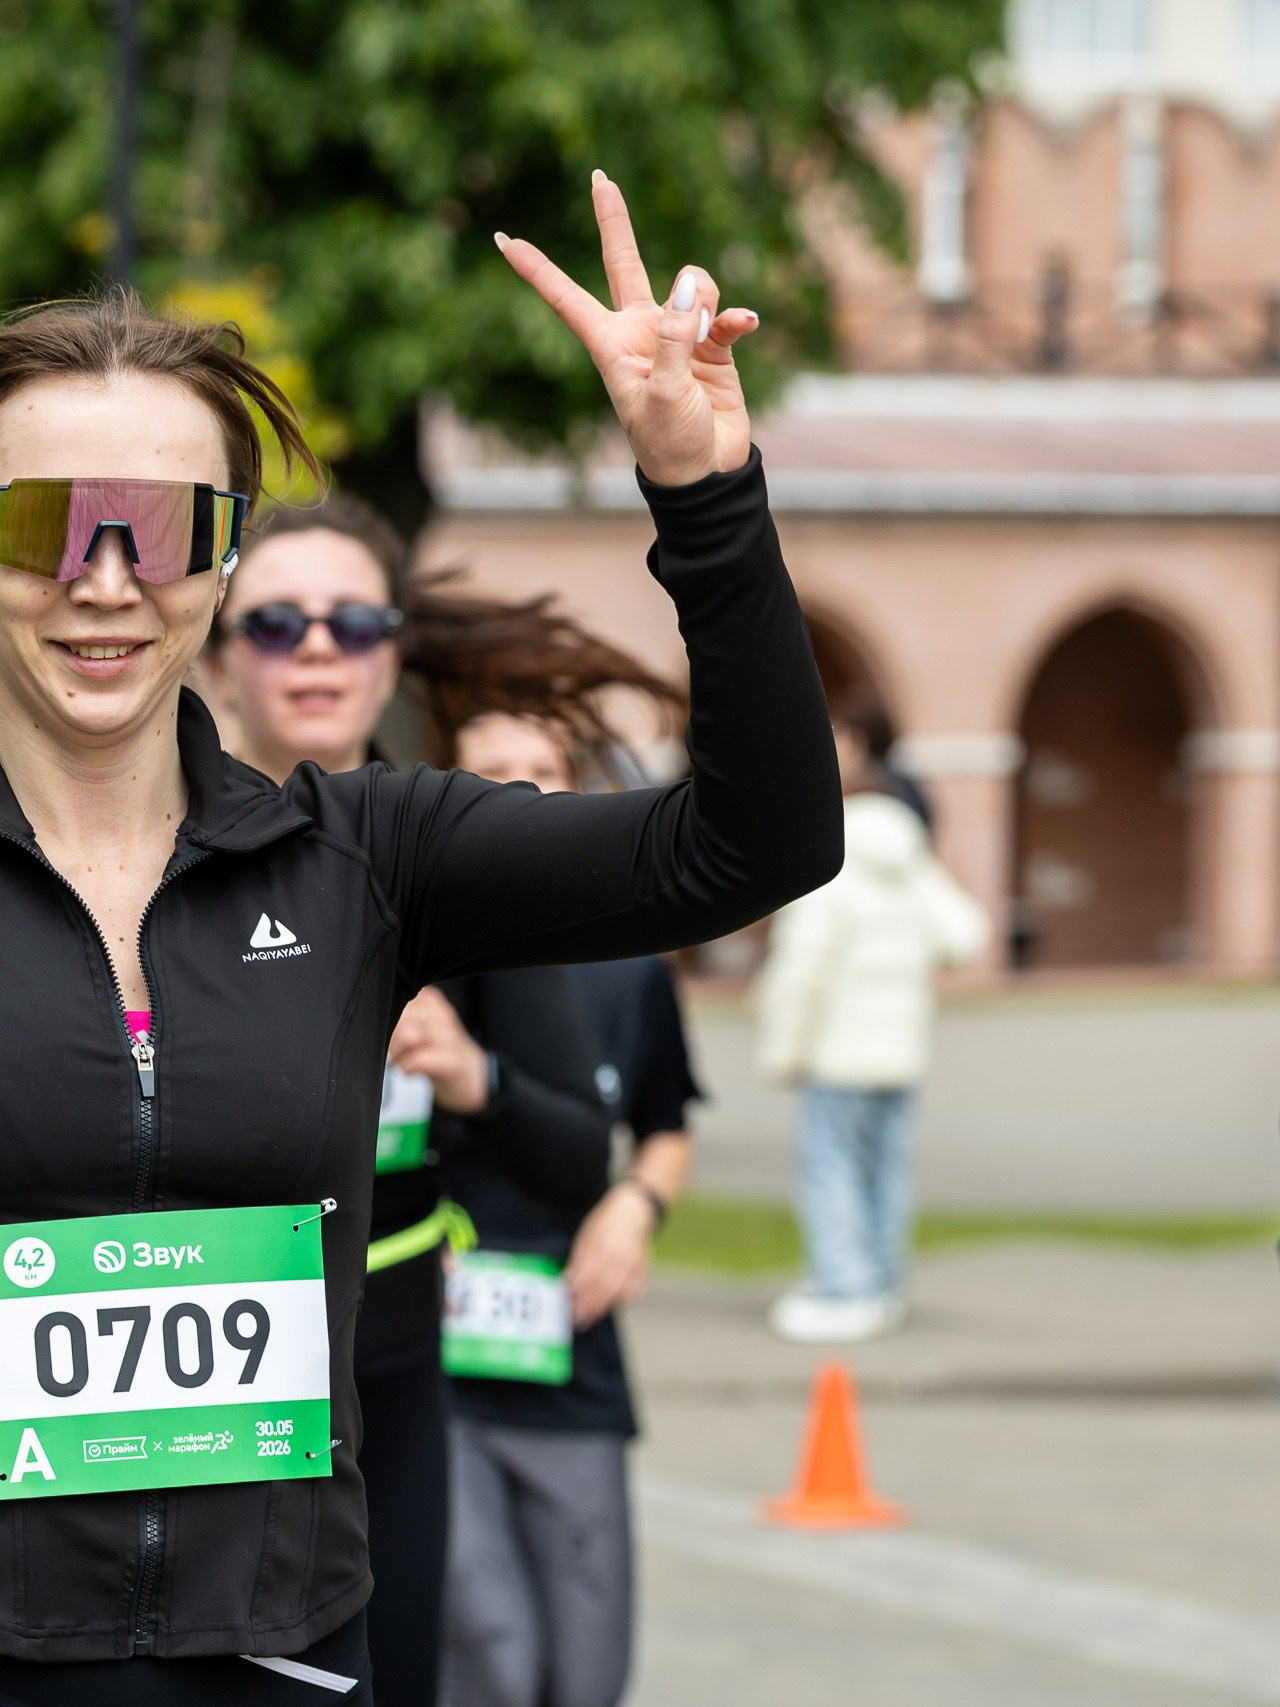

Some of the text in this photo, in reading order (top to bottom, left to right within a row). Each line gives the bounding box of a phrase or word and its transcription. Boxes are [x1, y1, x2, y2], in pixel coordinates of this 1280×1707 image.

[242, 943, 312, 963] NAQIYAYABEI
[14, 1247, 45, 1271] 4,2
[132, 1241, 205, 1270] Звук
[33, 1299, 271, 1398] 0709
[255, 1419, 294, 1437] 30.05
[172, 1432, 214, 1444] зелёный
[9, 1427, 57, 1484] A
[102, 1443, 138, 1456] Прайм
[168, 1443, 211, 1454] марафон
[256, 1439, 292, 1457] 2026
